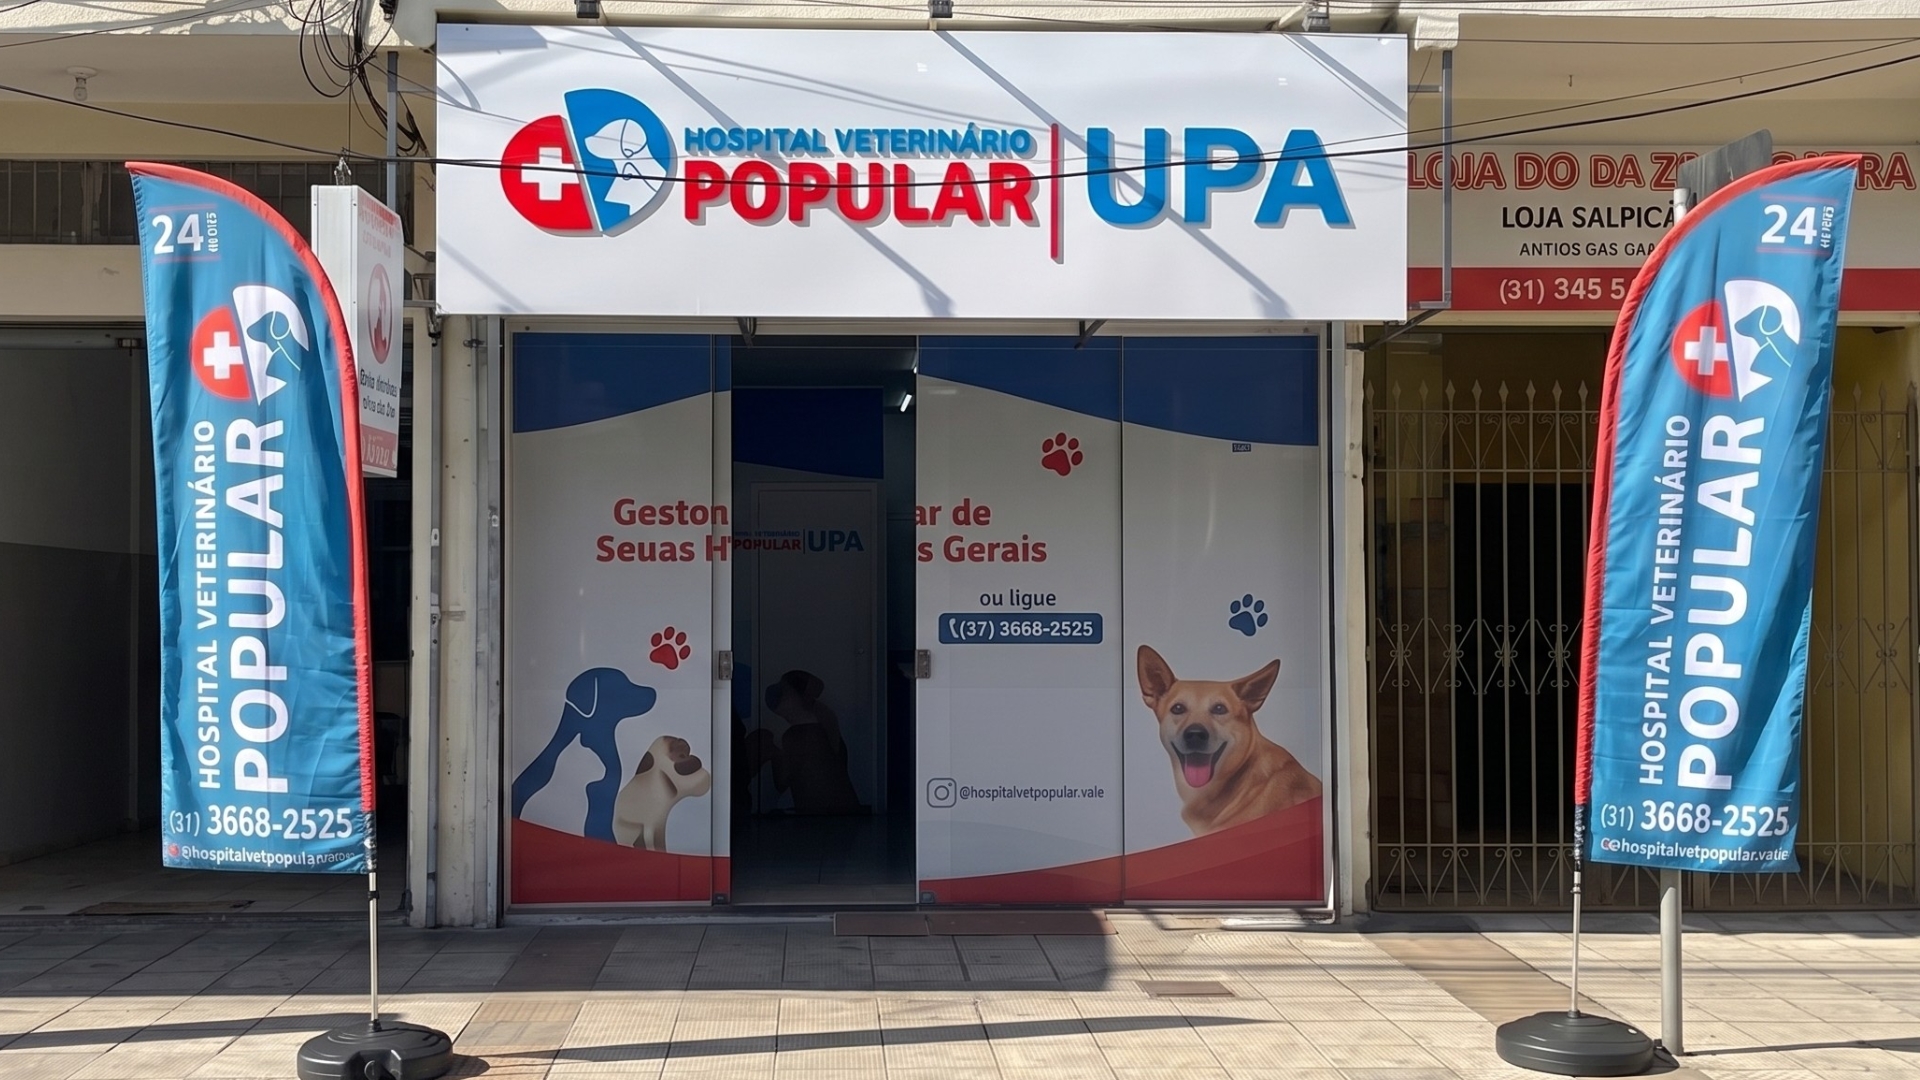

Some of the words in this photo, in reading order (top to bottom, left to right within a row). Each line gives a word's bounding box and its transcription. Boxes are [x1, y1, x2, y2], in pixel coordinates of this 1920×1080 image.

[683, 127, 831, 155] HOSPITAL
[835, 122, 1034, 157] VETERINÁRIO
[1086, 127, 1354, 227] UPA
[1408, 152, 1506, 190] LOJA
[1514, 152, 1580, 190] DO
[1590, 154, 1645, 188] DA
[684, 160, 1036, 223] POPULAR
[152, 213, 204, 255] 24
[1502, 206, 1564, 228] LOJA
[1761, 204, 1817, 245] 24
[1519, 243, 1581, 256] ANTIOS
[1585, 243, 1618, 256] GAS
[1500, 279, 1545, 305] (31)
[1554, 278, 1602, 300] 345
[187, 420, 217, 630] VETERINÁRIO
[613, 498, 729, 526] Geston
[952, 498, 991, 526] de
[1650, 415, 1690, 625] VETERINÁRIO
[596, 535, 695, 562] Seuas
[943, 534, 1047, 562] Gerais
[807, 530, 865, 552] UPA
[225, 418, 289, 793] POPULAR
[979, 593, 1004, 607] ou
[1009, 588, 1057, 611] ligue
[1677, 414, 1765, 791] POPULAR
[959, 620, 995, 640] (37)
[1000, 621, 1093, 637] 3668-2525
[196, 639, 221, 789] HOSPITAL
[1639, 635, 1673, 785] HOSPITAL
[959, 785, 1104, 802] @hospitalvetpopular.vale
[169, 810, 200, 837] (31)
[206, 804, 353, 840] 3668-2525
[1601, 803, 1634, 831] (31)
[1641, 800, 1789, 837] 3668-2525
